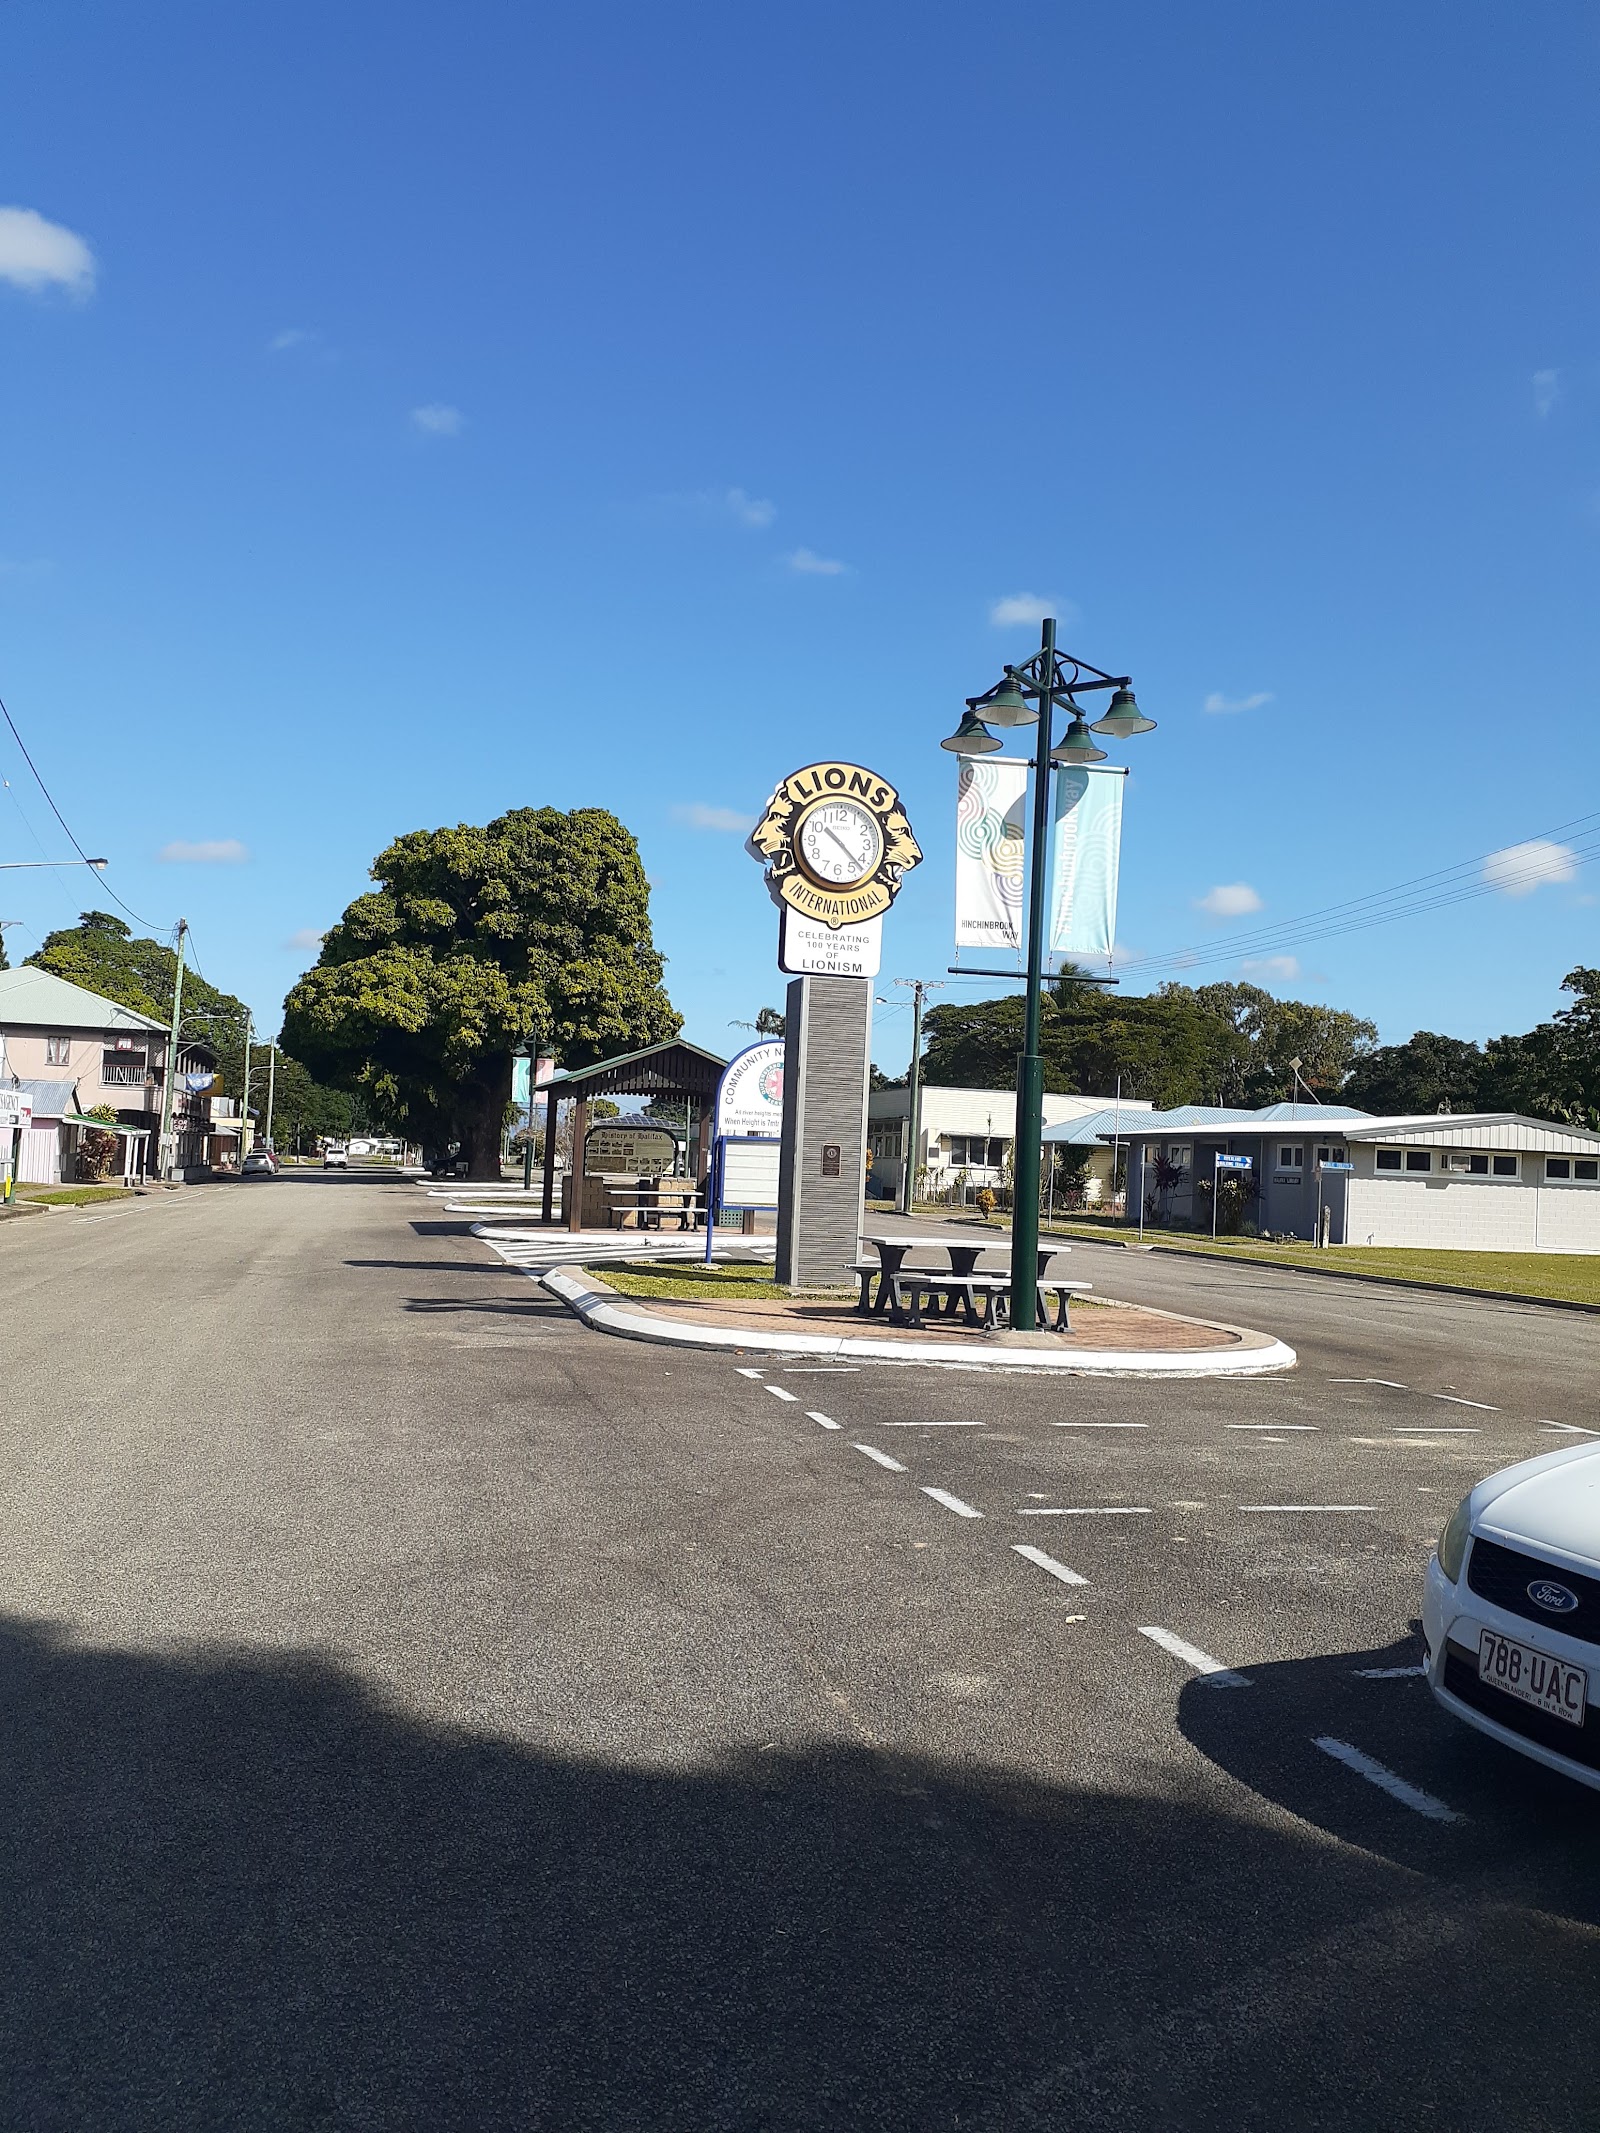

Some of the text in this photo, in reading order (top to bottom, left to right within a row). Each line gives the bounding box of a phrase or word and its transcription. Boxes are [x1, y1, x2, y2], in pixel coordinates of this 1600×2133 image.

[794, 768, 890, 806] LIONS
[824, 812, 832, 823] 11
[836, 810, 847, 822] 12
[812, 820, 823, 833] 10
[860, 824, 868, 836] 2
[808, 834, 816, 846] 9
[862, 838, 871, 850] 3
[812, 848, 820, 860] 8
[858, 852, 866, 864] 4
[822, 860, 830, 871] 7
[834, 864, 842, 876] 6
[847, 862, 856, 873] 5
[788, 882, 883, 916] INTERNATIONAL
[962, 920, 1012, 930] HINCHINBROOK
[798, 930, 870, 944] CELEBRATING
[1002, 930, 1018, 940] WAY
[826, 942, 860, 952] YEARS
[802, 959, 862, 973] LIONISM
[725, 1048, 770, 1104] COMMUNITY
[742, 1118, 760, 1127] Height
[1536, 1585, 1566, 1606] Ford
